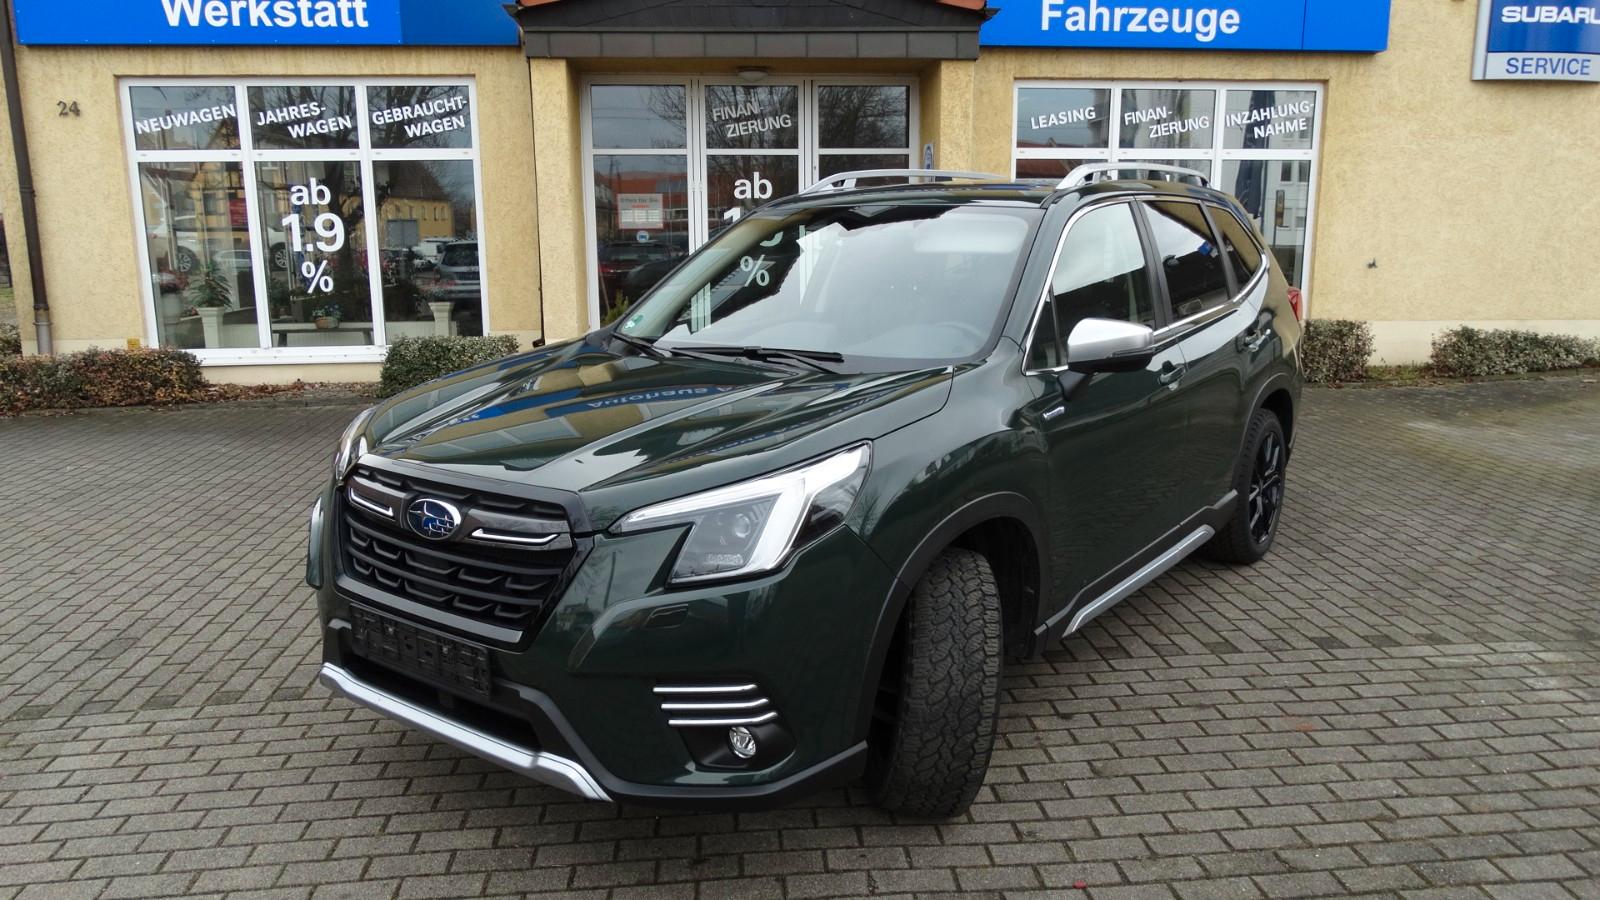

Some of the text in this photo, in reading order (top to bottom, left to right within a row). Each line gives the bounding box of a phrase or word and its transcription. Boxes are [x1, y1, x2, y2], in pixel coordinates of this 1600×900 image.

[161, 0, 369, 28] Werkstatt
[1041, 0, 1240, 43] Fahrzeuge
[1505, 57, 1591, 76] SERVICE
[56, 100, 81, 117] 24
[135, 103, 236, 134] NEUWAGEN
[256, 101, 327, 126] JAHRES-
[371, 95, 468, 125] GEBRAUCHT-
[712, 101, 764, 122] FINAN-
[1030, 106, 1096, 130] LEASING
[1123, 105, 1173, 126] FINAN-
[1225, 100, 1315, 127] INZAHLUNG-
[287, 115, 352, 139] WAGEN
[404, 115, 466, 138] WAGEN
[725, 114, 792, 138] ZIERUNG
[1149, 116, 1209, 138] ZIERUNG
[1253, 117, 1308, 139] NAHME
[290, 177, 331, 205] ab
[733, 171, 773, 199] ab
[281, 212, 345, 252] 1.9
[301, 259, 334, 294] %
[739, 254, 770, 287] %
